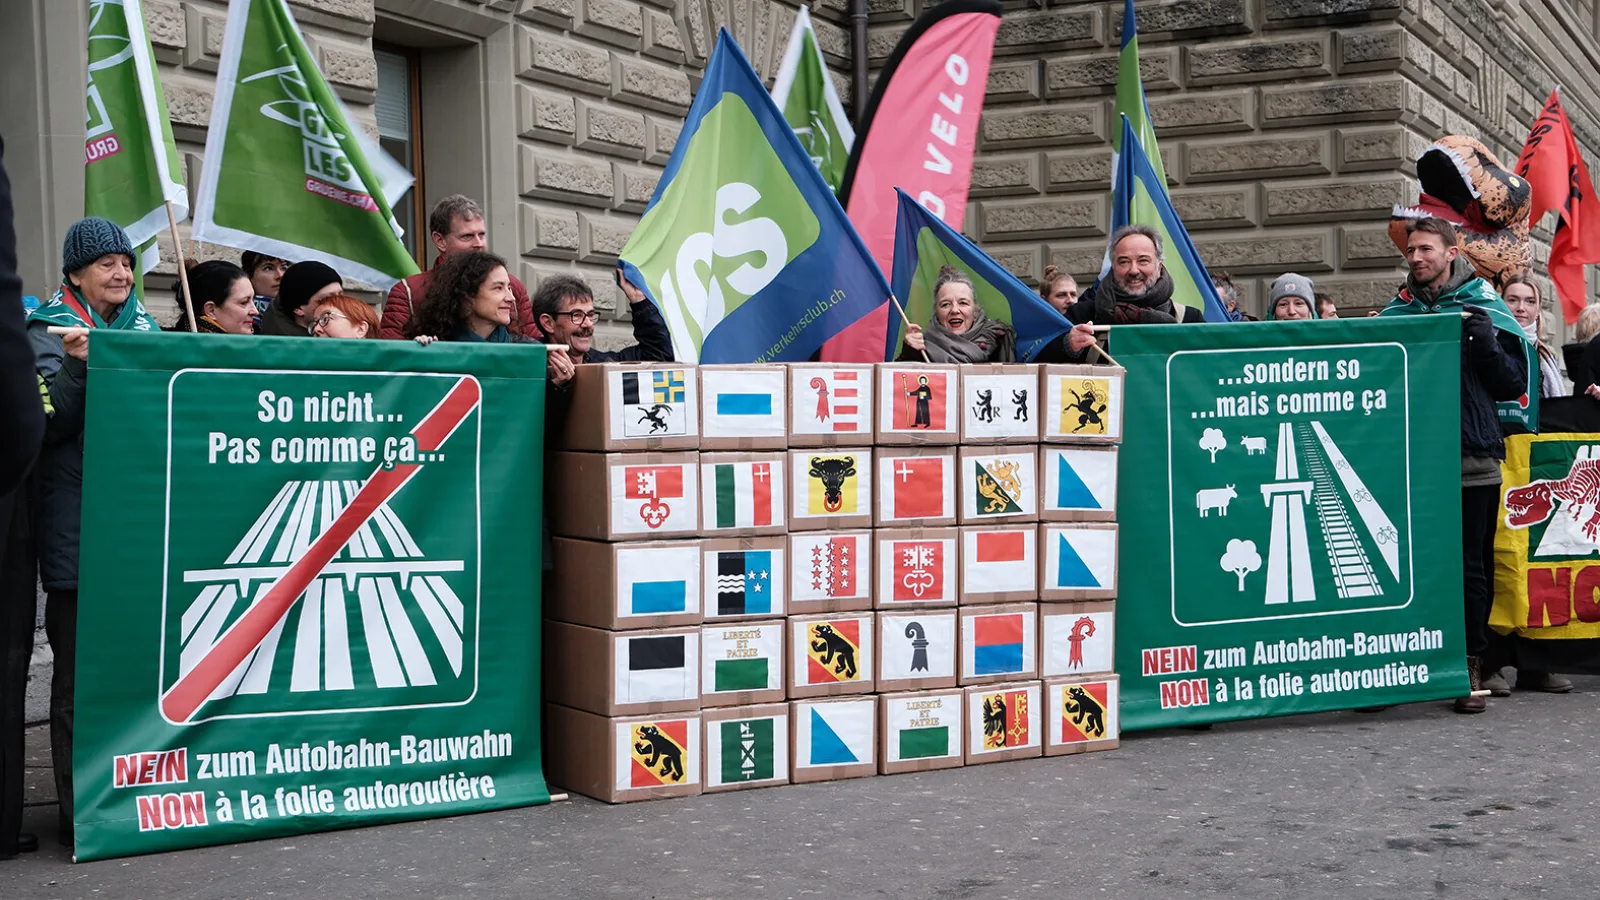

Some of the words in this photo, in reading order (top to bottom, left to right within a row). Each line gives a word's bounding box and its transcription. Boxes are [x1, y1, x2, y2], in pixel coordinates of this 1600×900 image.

[924, 53, 969, 174] VELO
[307, 146, 350, 182] LES
[1336, 358, 1360, 380] so
[257, 389, 293, 423] So
[303, 390, 403, 423] nicht...
[1276, 390, 1354, 415] comme
[1361, 388, 1387, 416] ça
[208, 432, 261, 464] Pas
[271, 436, 376, 463] comme
[383, 436, 445, 468] ça...
[722, 628, 762, 640] LIBERTÉ
[736, 640, 749, 649] ET
[1141, 645, 1197, 676] NEIN
[1203, 646, 1246, 670] zum
[1253, 627, 1443, 665] Autobahn-Bauwahn
[726, 648, 759, 658] PATRIE
[1160, 678, 1210, 709] NON
[1215, 678, 1228, 703] à
[1234, 677, 1254, 701] la
[1259, 672, 1304, 699] folie
[1310, 661, 1429, 694] autoroutière
[919, 709, 931, 718] ET
[113, 747, 188, 788] NEIN
[196, 750, 256, 780] zum
[265, 729, 512, 775] Autobahn-Bauwahn
[136, 791, 208, 832] NON
[215, 791, 234, 822] à
[240, 790, 269, 820] la
[274, 784, 335, 817] folie
[343, 771, 496, 812] autoroutière
